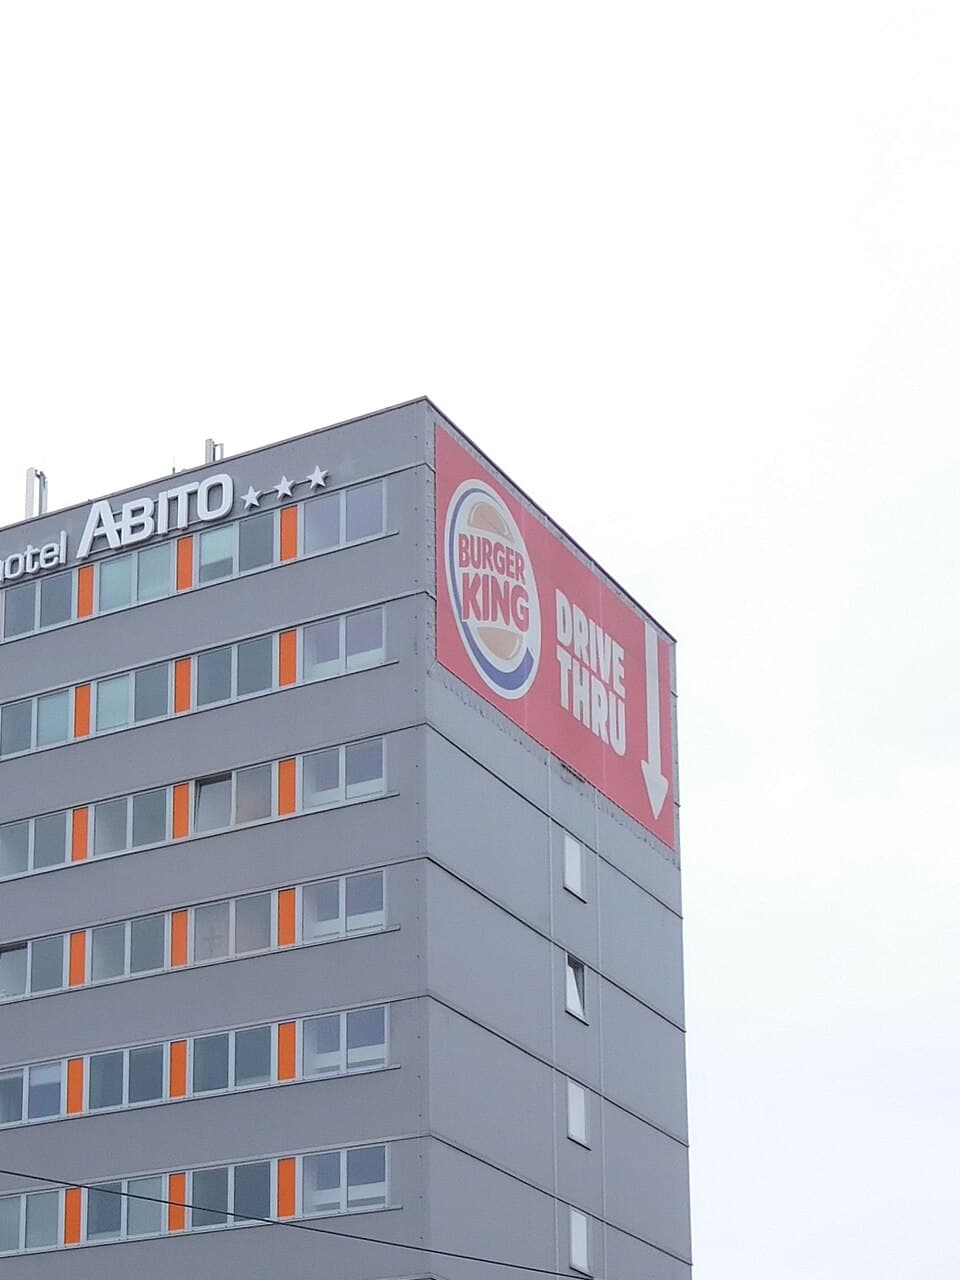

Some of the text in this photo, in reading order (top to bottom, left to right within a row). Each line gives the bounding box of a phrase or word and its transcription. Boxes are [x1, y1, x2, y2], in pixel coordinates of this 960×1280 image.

[458, 533, 526, 585] BURGER
[461, 572, 530, 633] KING
[555, 587, 625, 695] DRIVE
[556, 645, 626, 757] THRU
